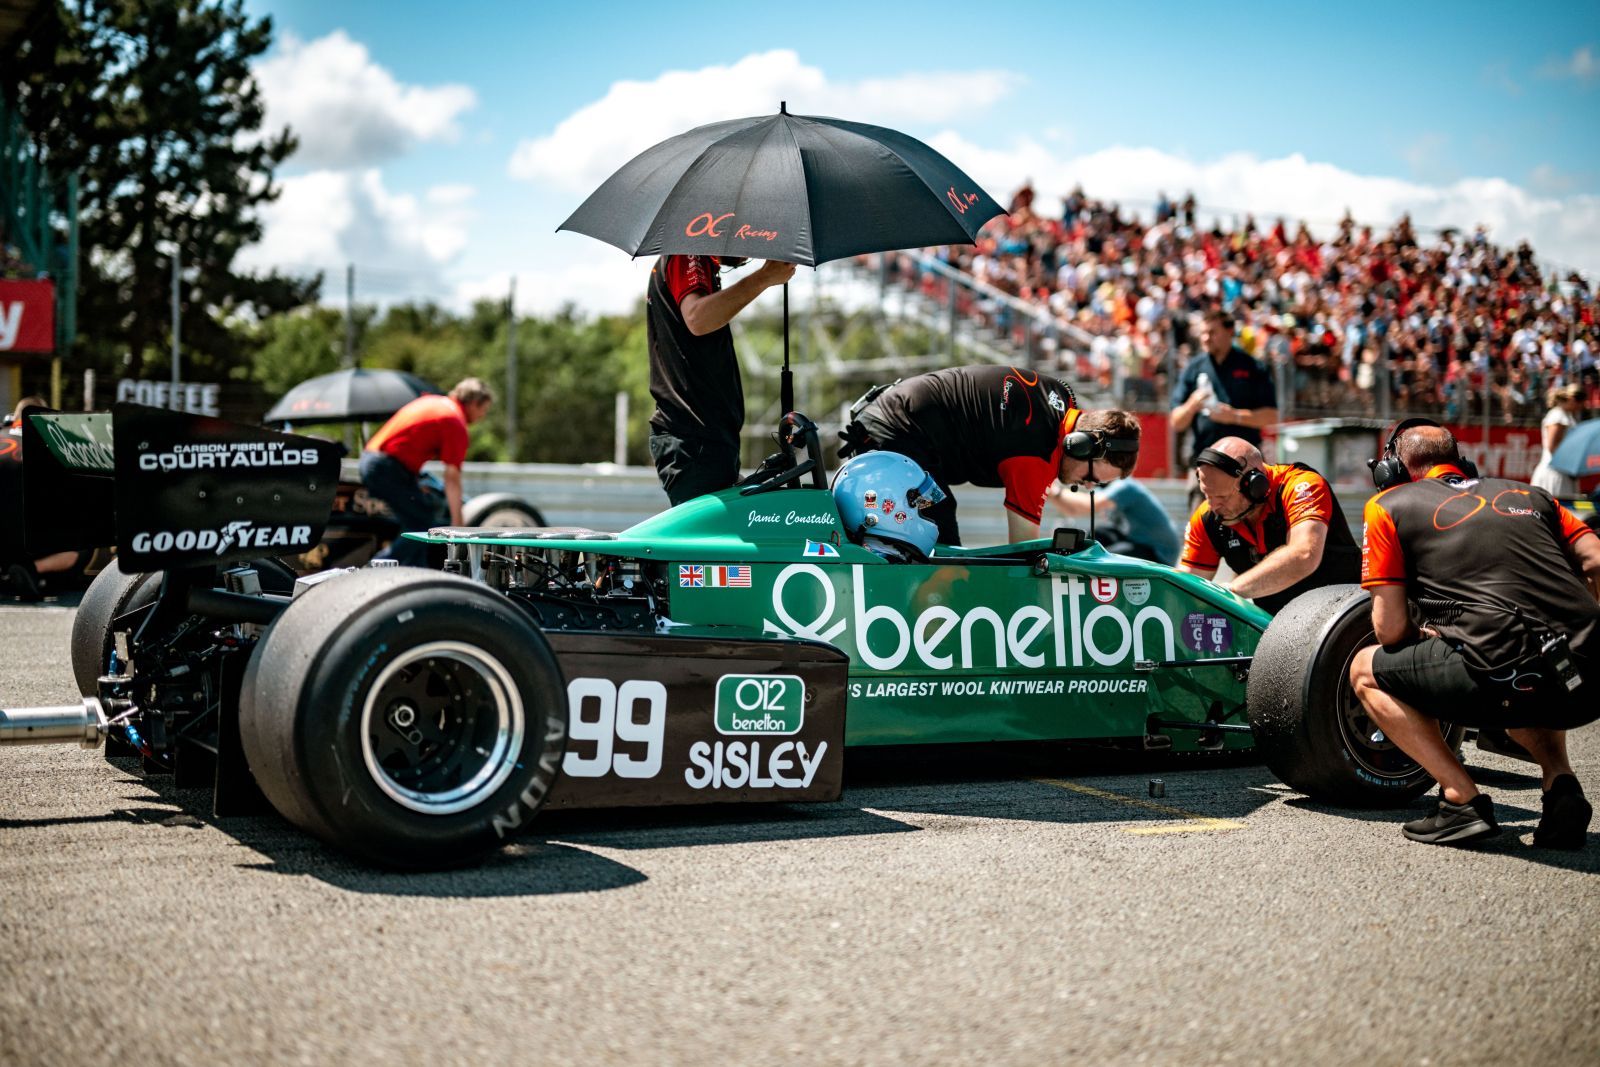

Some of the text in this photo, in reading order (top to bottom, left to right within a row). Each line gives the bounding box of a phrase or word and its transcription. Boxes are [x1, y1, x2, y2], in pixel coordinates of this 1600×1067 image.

[735, 224, 778, 241] Racing
[116, 378, 221, 418] COFFEE
[173, 442, 285, 453] CARBON FIBRE BY
[139, 449, 319, 470] COURTAULDS
[748, 510, 835, 527] Jamie Constable
[852, 563, 1176, 670] benetton
[866, 682, 937, 697] LARGEST
[941, 681, 986, 696] WOOL
[989, 680, 1064, 695] KNITWEAR
[1067, 679, 1147, 694] PRODUCER
[562, 677, 667, 778] 99
[732, 712, 786, 731] benetton
[685, 741, 828, 789] SISLEY
